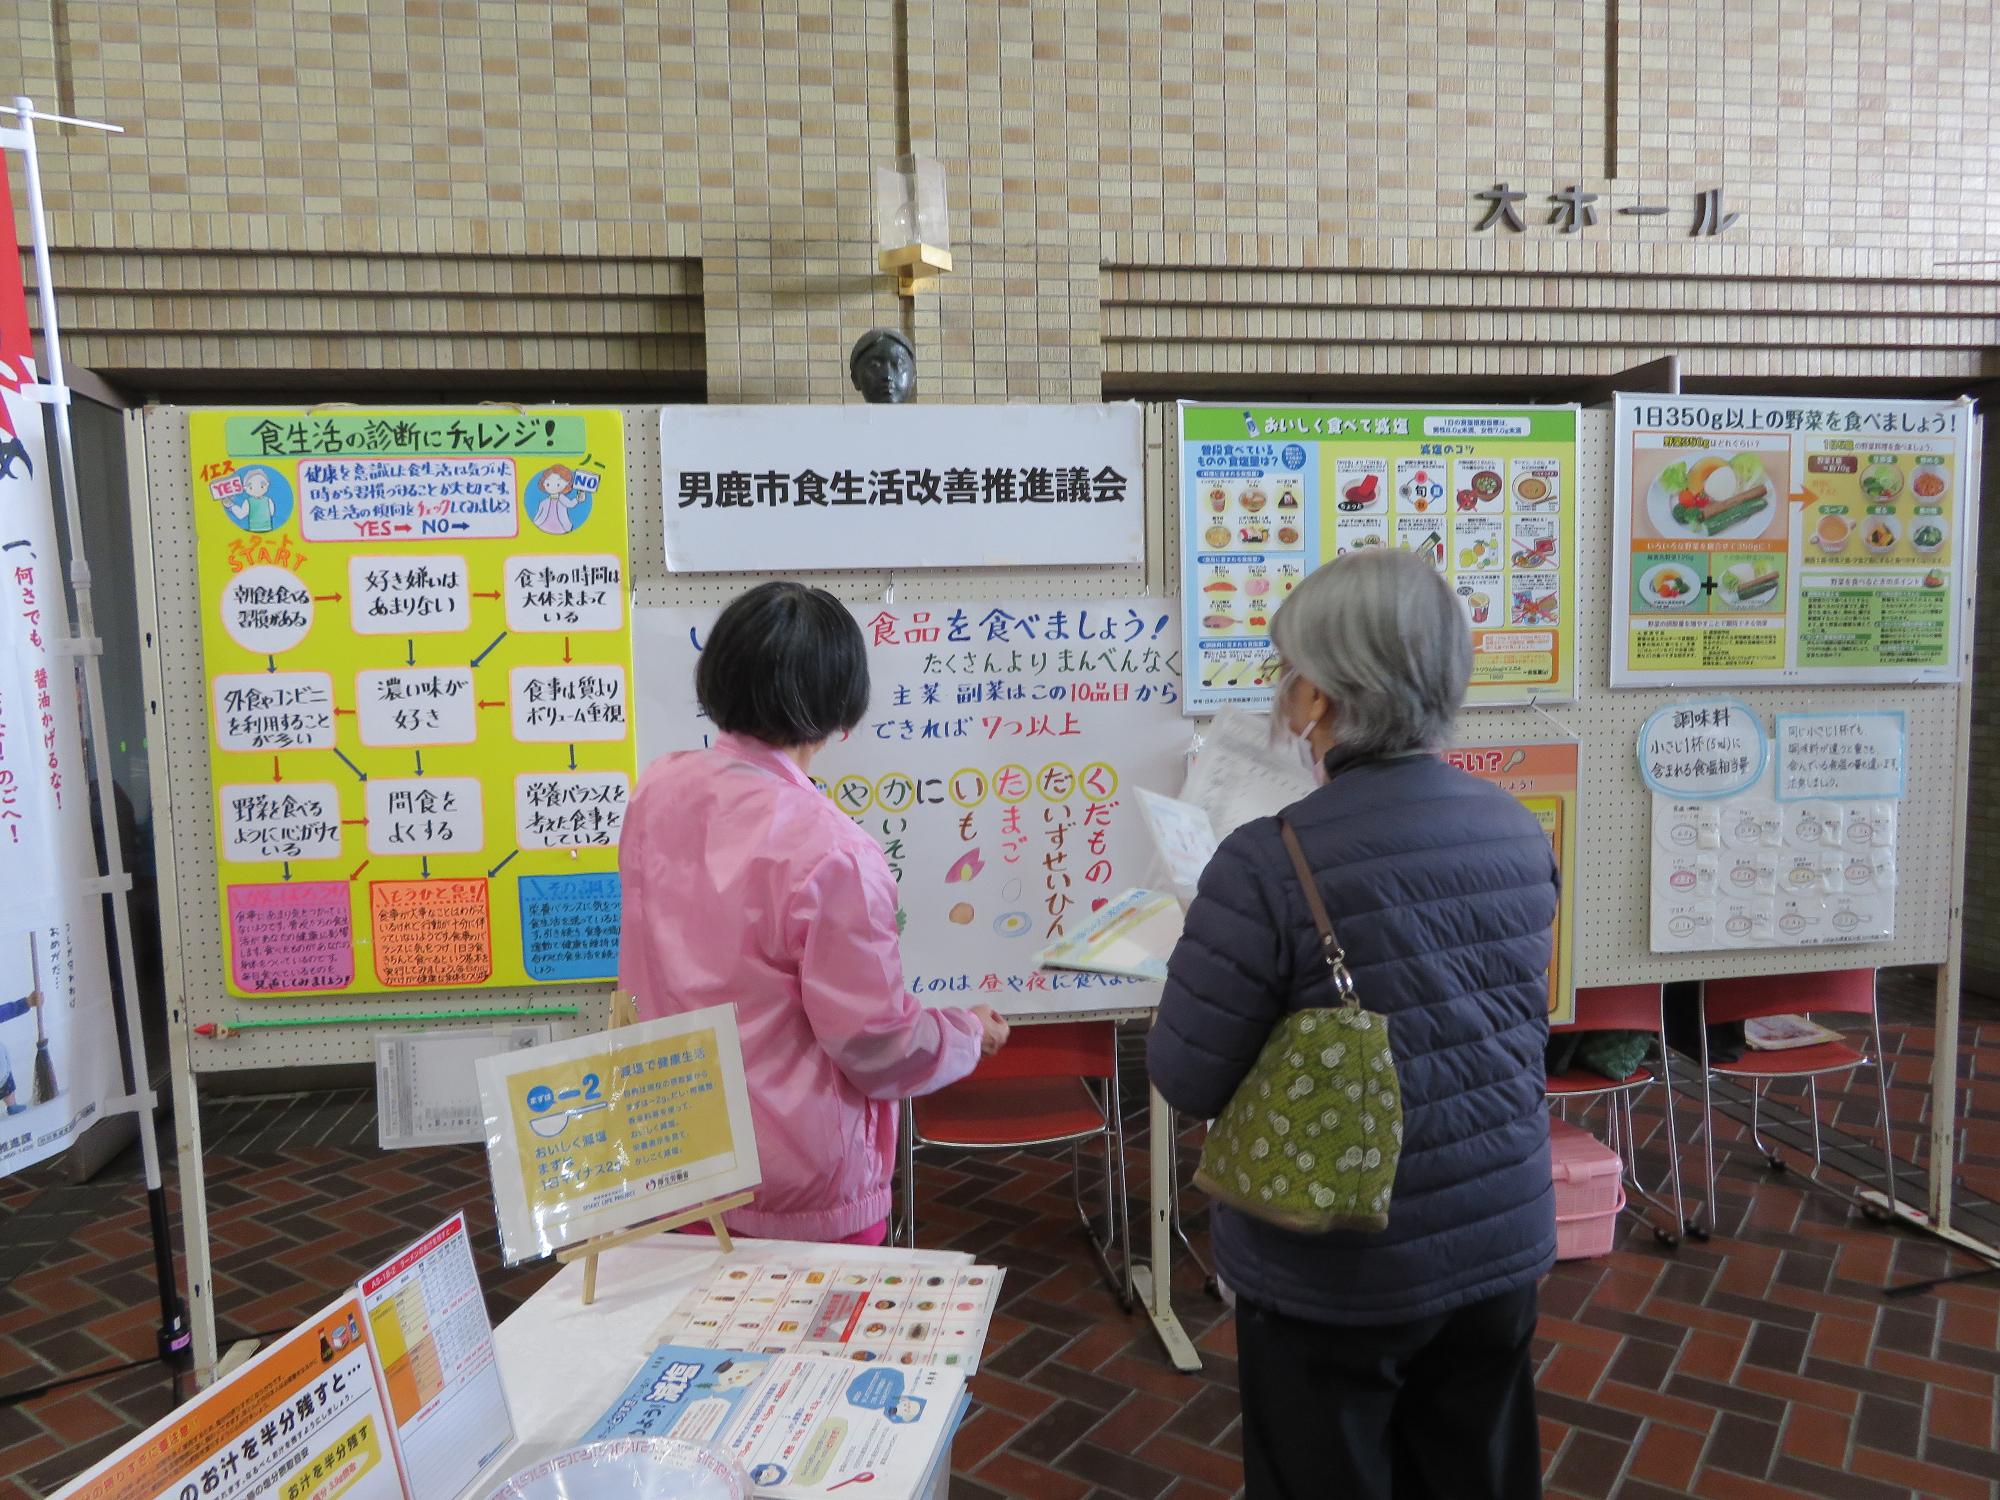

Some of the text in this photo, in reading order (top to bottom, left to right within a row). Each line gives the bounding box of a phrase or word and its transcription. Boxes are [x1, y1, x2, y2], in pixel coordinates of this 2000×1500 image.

[1476, 183, 1740, 238] 大ホール
[1264, 416, 1410, 436] おいしく食べて減塩
[1633, 406, 1956, 434] 1日350g以上の野菜を食べましょう!
[250, 418, 556, 455] 食生活の診断にチャレンジ!
[1200, 444, 1274, 456] 普段食べている
[1420, 443, 1475, 455] 減塩のコツ
[213, 479, 242, 498] YES
[573, 474, 599, 491] NO
[678, 466, 1128, 508] 男鹿市食生活改善推進議会
[354, 520, 392, 537] YES
[422, 518, 449, 535] NO
[228, 545, 308, 573] START
[365, 568, 460, 592] 好き嫌いは
[515, 565, 621, 588] 食事の時間は
[233, 584, 310, 606] 朝食を食べる
[368, 595, 457, 617] あまりない
[521, 588, 608, 609] 大体決まって
[238, 608, 308, 630] 習慣がある
[543, 609, 580, 625] いる
[867, 608, 1171, 648] 食品を食べましょう!
[224, 686, 328, 713] 外食やコンビニ
[378, 676, 470, 700] 濃い味が
[524, 676, 620, 702] 食事は質より
[229, 713, 330, 737] を利用すること
[393, 708, 442, 731] 好き
[526, 704, 626, 727] ボリューム重視
[871, 711, 1082, 741] できれば 7つ以上
[1672, 706, 1731, 729] 調味料
[252, 733, 312, 748] が多い
[1651, 756, 1750, 779] 含まれる食塩相当量
[388, 788, 457, 815] 間食を
[525, 782, 627, 808] 栄養バランスを
[232, 794, 324, 821] 野菜を食べる
[233, 822, 341, 845] ように心がけて
[388, 821, 454, 844] よくする
[526, 810, 622, 834] 考えた食事を
[261, 842, 303, 857] いる
[542, 831, 611, 847] している
[620, 1047, 706, 1079] 減塩で健康生活
[535, 1130, 608, 1159] おいしく減塩
[287, 1424, 369, 1500] お汁を半分残す
